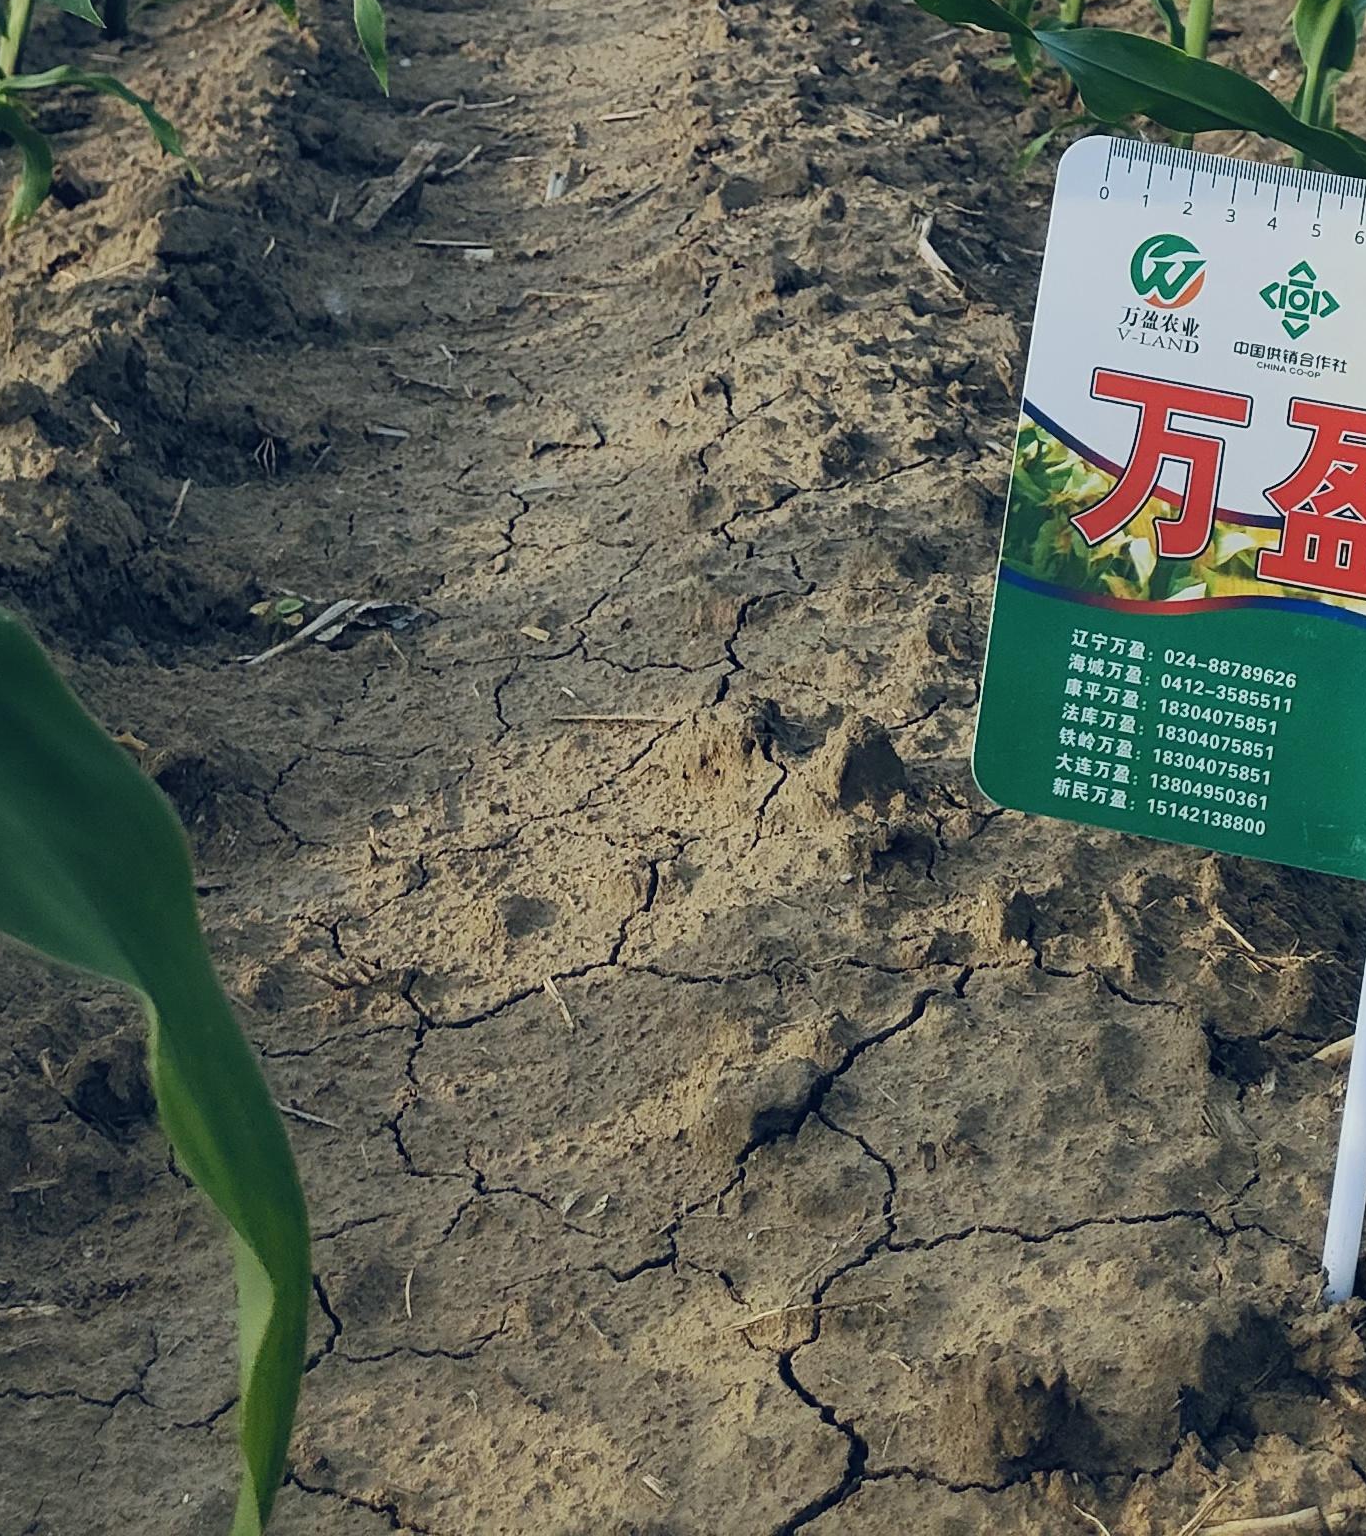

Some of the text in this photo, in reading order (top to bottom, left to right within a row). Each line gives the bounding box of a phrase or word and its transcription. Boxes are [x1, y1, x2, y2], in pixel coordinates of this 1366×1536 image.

[1099, 186, 1109, 200] 0
[1142, 194, 1149, 207] 1
[1182, 202, 1193, 215] 2
[1225, 209, 1236, 223] 3
[1267, 217, 1277, 230] 4
[1311, 224, 1322, 238] 5
[1354, 231, 1365, 244] 6
[1117, 327, 1200, 354] V-LAND
[1119, 306, 1200, 339] 万盈农业
[1233, 341, 1348, 373] 中国供销合作社
[1257, 361, 1321, 378] CHINA CO-OP
[1164, 649, 1297, 689] 024-88789626
[1161, 673, 1292, 713] 0412-3585511
[1159, 698, 1278, 735] 18304075851
[1156, 723, 1274, 760] 18304075851
[1153, 748, 1271, 785] 18304075851
[1150, 773, 1268, 811] 13804950361
[1147, 798, 1266, 836] 15142138800
